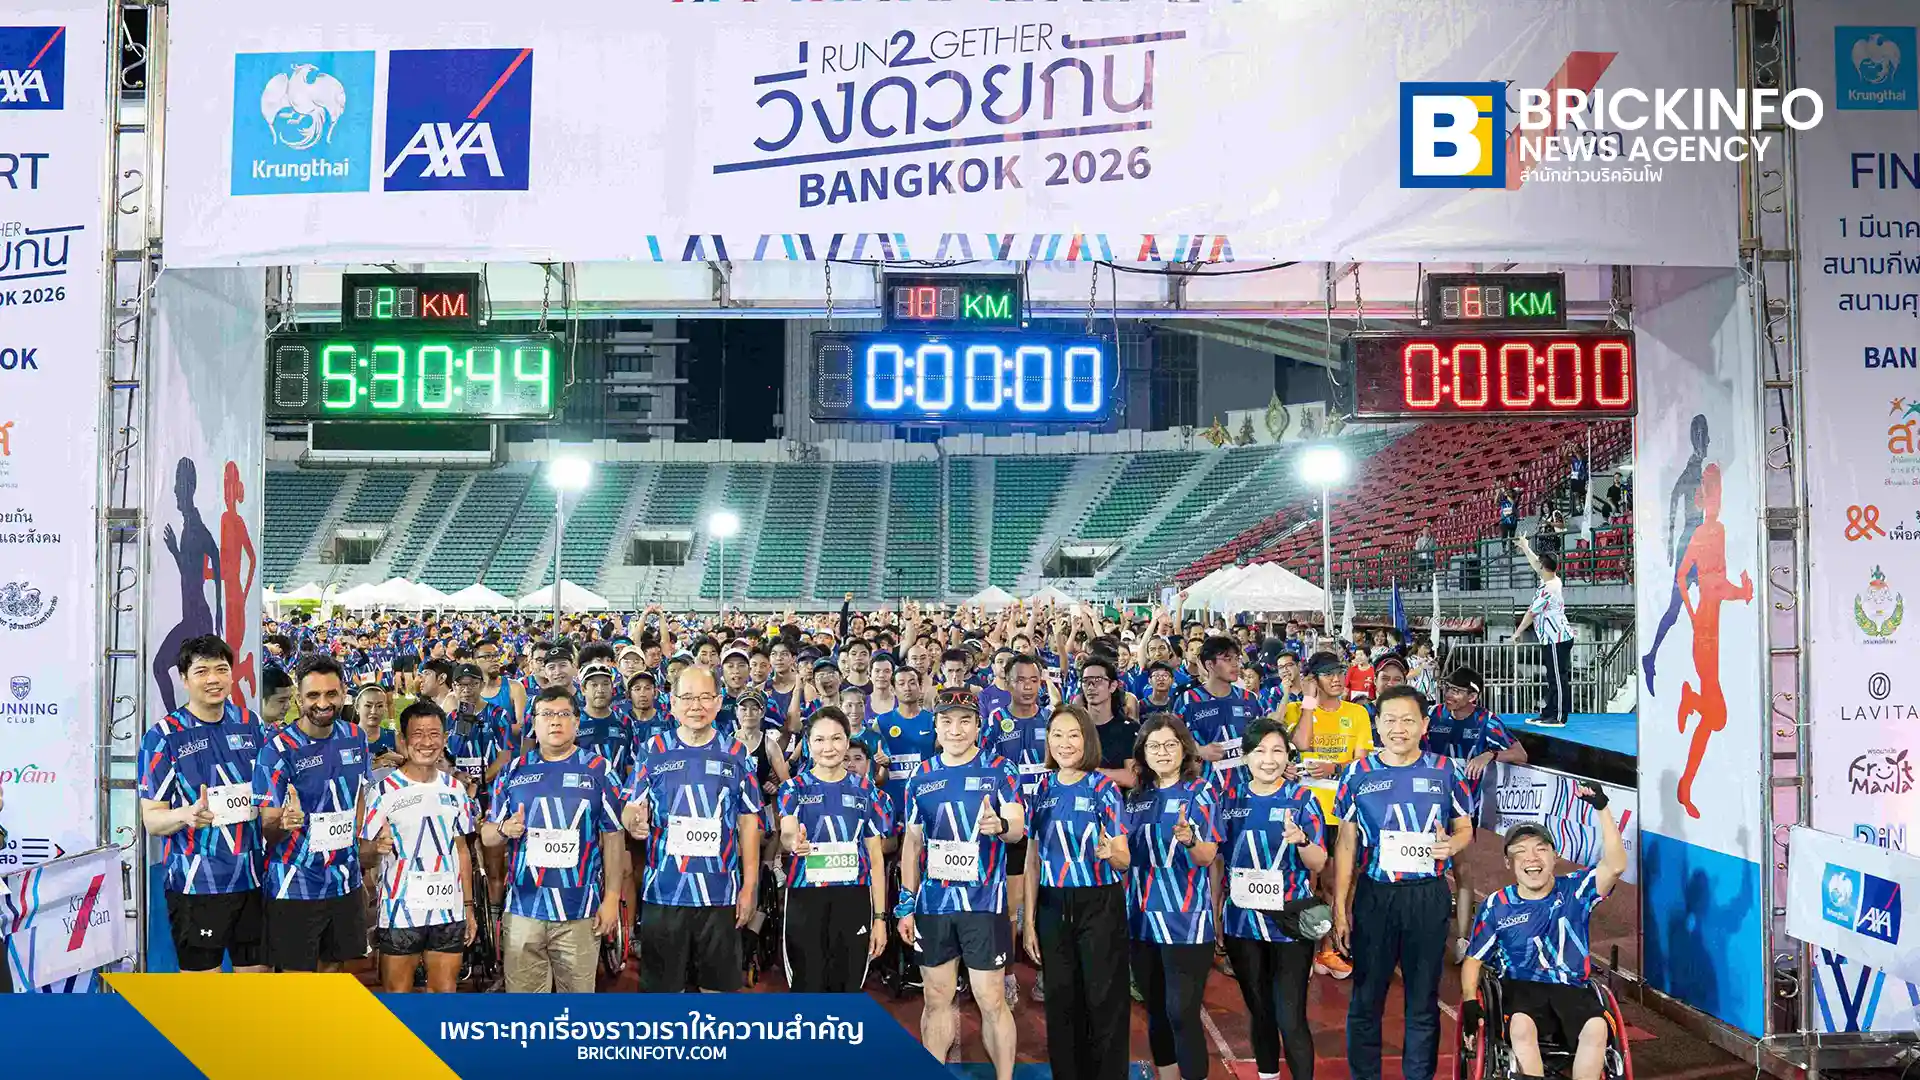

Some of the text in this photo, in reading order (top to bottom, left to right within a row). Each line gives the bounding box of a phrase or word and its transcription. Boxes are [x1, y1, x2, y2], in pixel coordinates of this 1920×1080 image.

[1848, 89, 1906, 103] Krungthai
[384, 123, 504, 177] AXA
[252, 158, 349, 182] Krungthai
[800, 146, 1151, 208] BANGKOK 2026
[1851, 152, 1920, 189] FIN
[1839, 217, 1847, 238] 1
[22, 286, 65, 304] 2026
[377, 288, 468, 318] 2 KM.
[907, 287, 1012, 319] 10 KM.
[1464, 287, 1556, 317] 6 KM.
[1864, 347, 1917, 369] BAN
[322, 344, 551, 409] 5:30:44
[866, 345, 1101, 411] 0:00:00
[1405, 343, 1629, 407] 0:00:00
[1841, 705, 1919, 721] LAVITA
[226, 796, 251, 809] 000
[329, 822, 352, 836] 0005
[686, 830, 718, 842] 0099
[544, 842, 576, 854] 0057
[1400, 846, 1432, 858] 0039
[824, 855, 856, 868] 2088
[944, 854, 975, 867] 0007
[427, 884, 454, 896] 0160
[1248, 882, 1280, 894] 0008
[88, 908, 110, 927] Can
[1856, 906, 1892, 937] AXA
